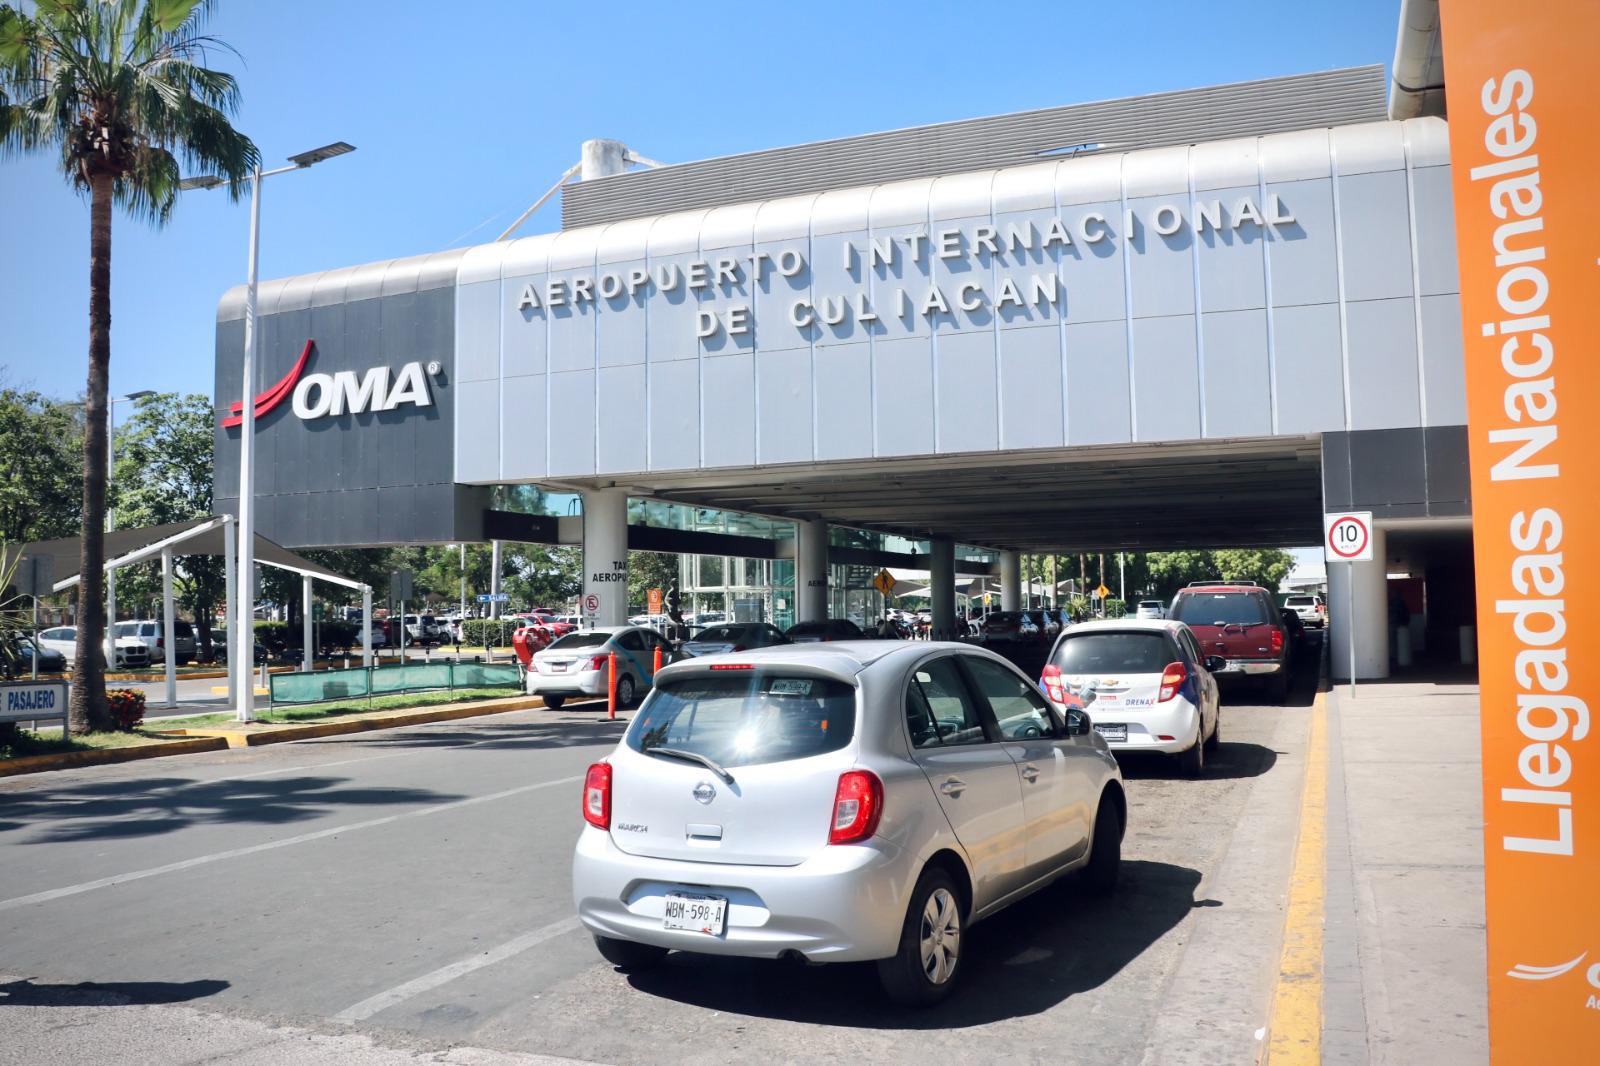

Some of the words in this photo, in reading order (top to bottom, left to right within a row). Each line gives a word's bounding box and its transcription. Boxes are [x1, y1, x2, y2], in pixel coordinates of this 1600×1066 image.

[518, 250, 802, 312] AEROPUERTO
[843, 194, 1296, 270] INTERNACIONAL
[1470, 68, 1560, 481] Nacionales
[696, 305, 749, 339] DE
[789, 273, 1060, 328] CULIACAN
[1339, 524, 1358, 543] 10
[8, 689, 55, 711] PASAJERO
[1125, 698, 1155, 707] DRENAX
[1495, 507, 1590, 857] Llegadas
[665, 901, 722, 923] WBM-598-A
